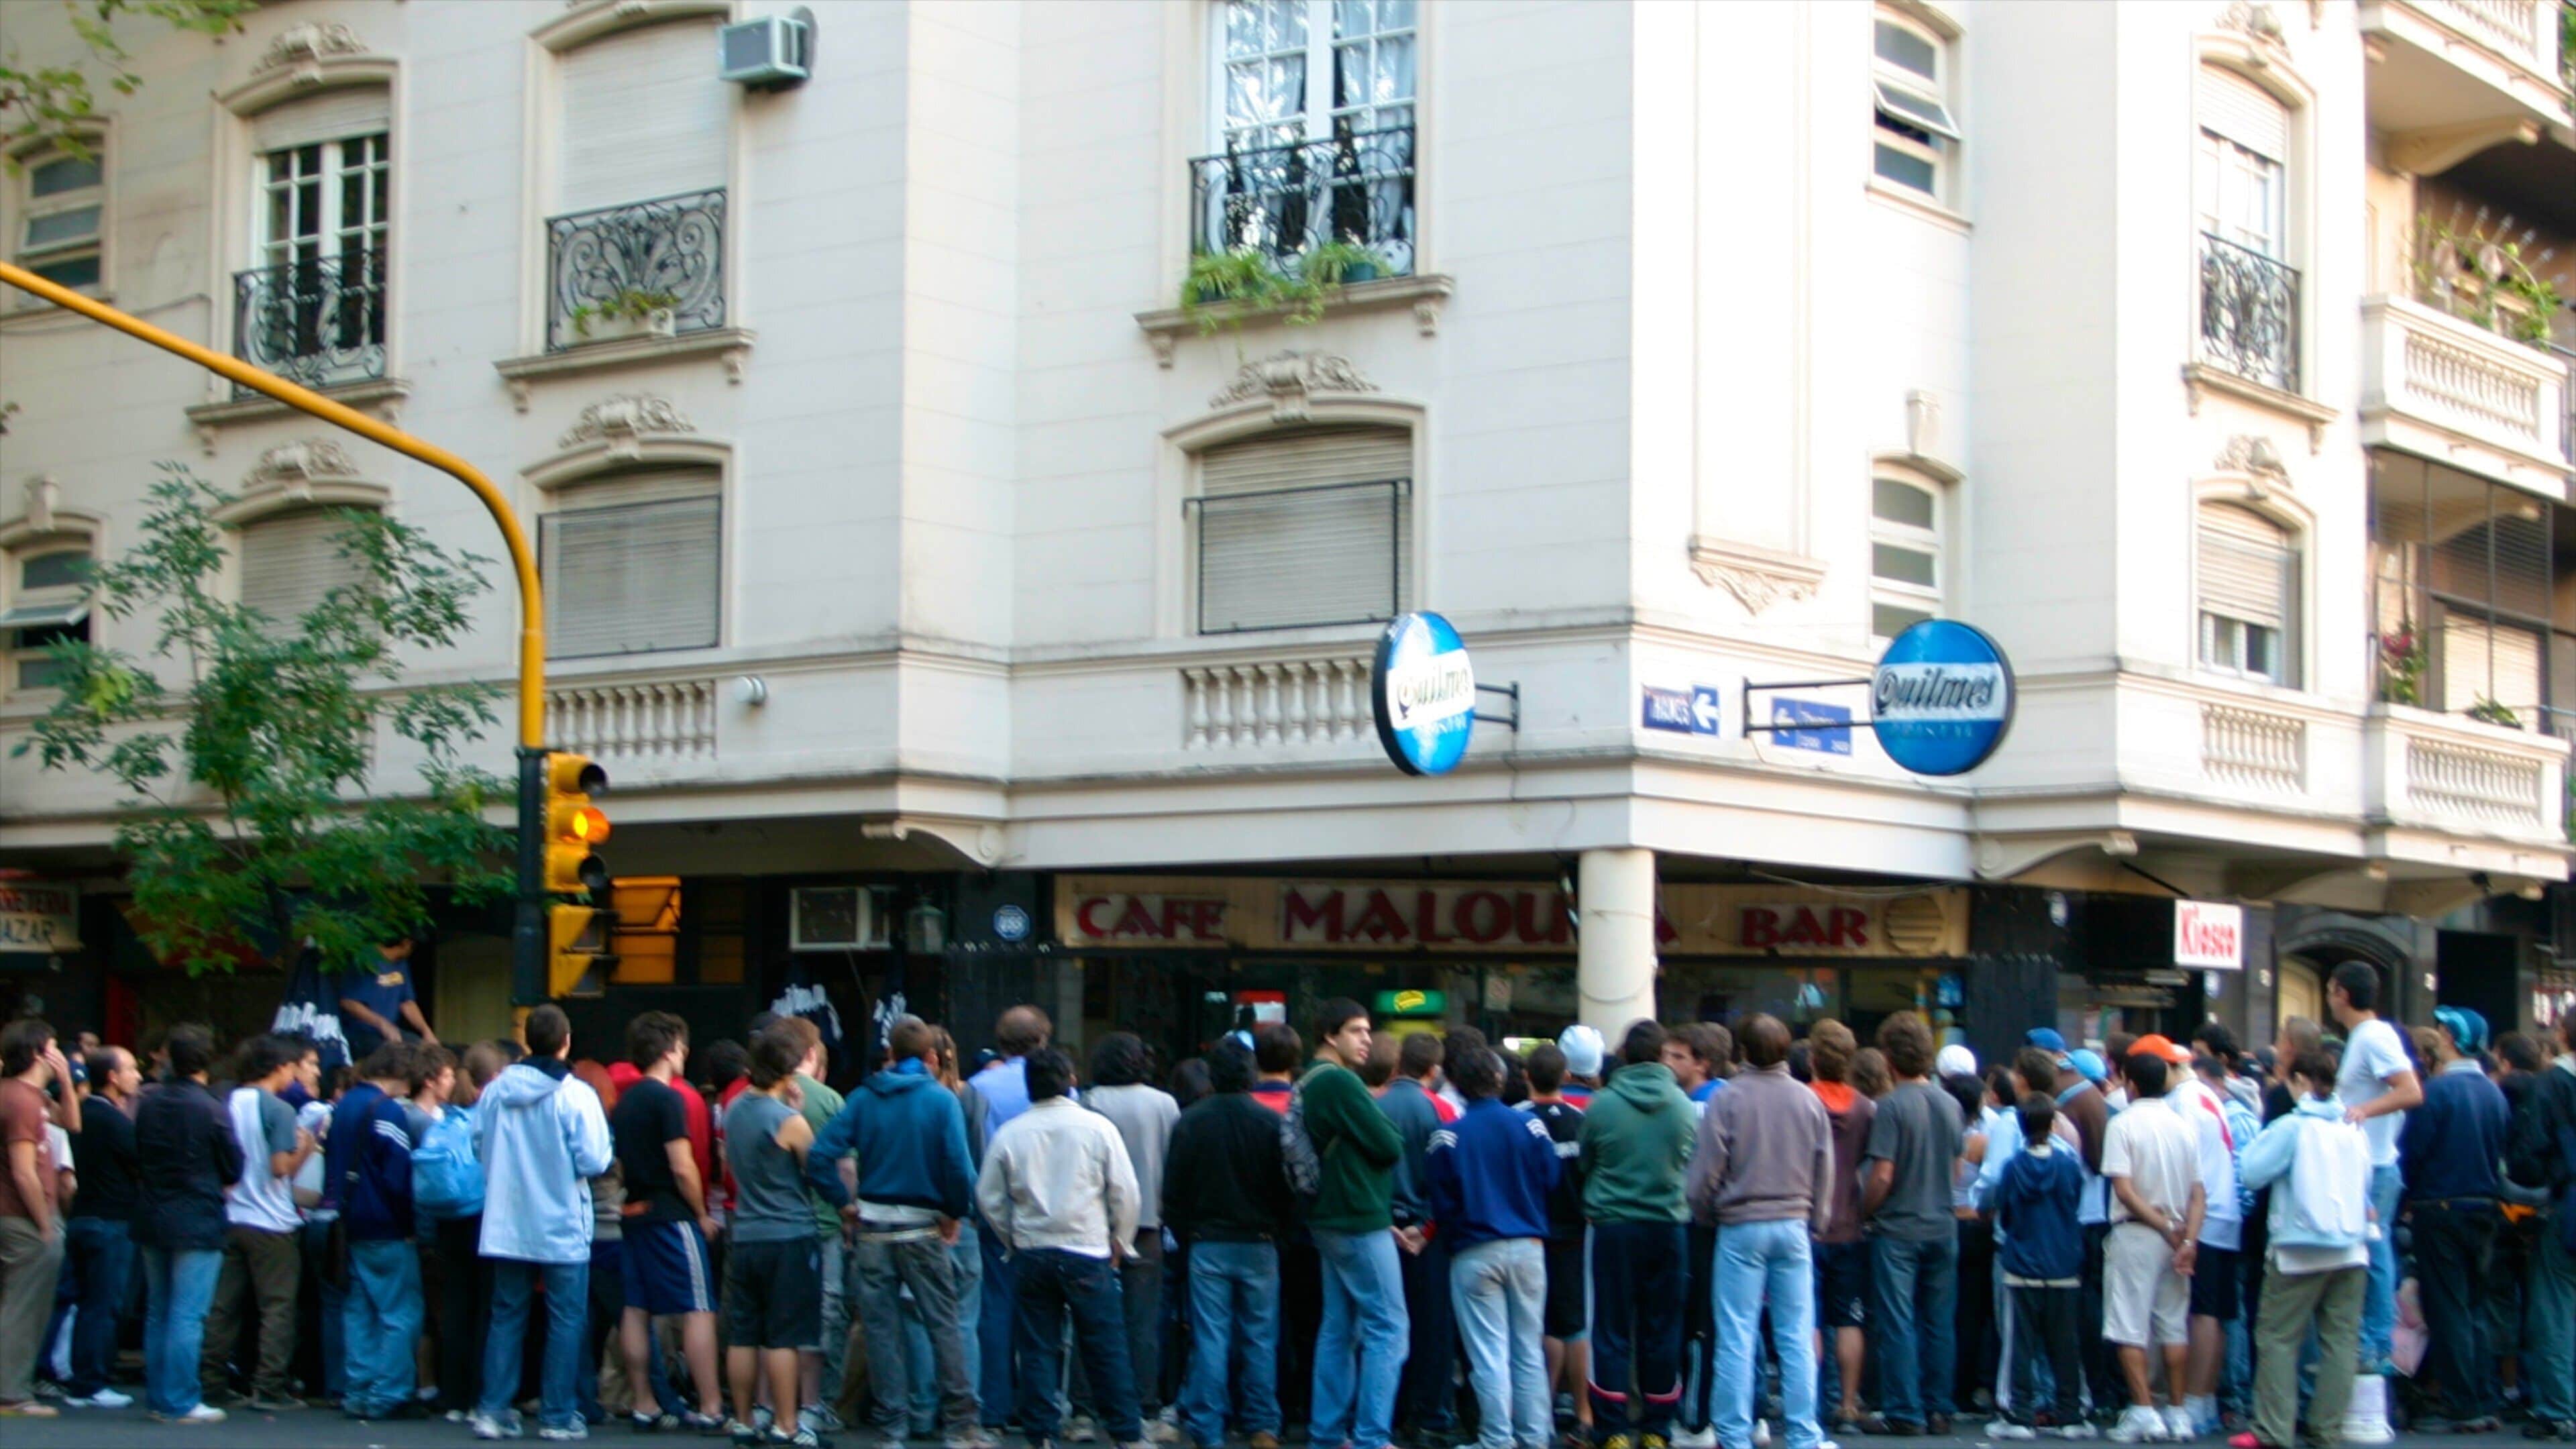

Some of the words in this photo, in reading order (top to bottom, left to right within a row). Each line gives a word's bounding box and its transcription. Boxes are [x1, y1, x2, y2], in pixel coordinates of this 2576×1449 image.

[1876, 667, 1998, 716] Quilmes
[1077, 896, 1225, 941] CAFE
[1741, 906, 1868, 948] BAR
